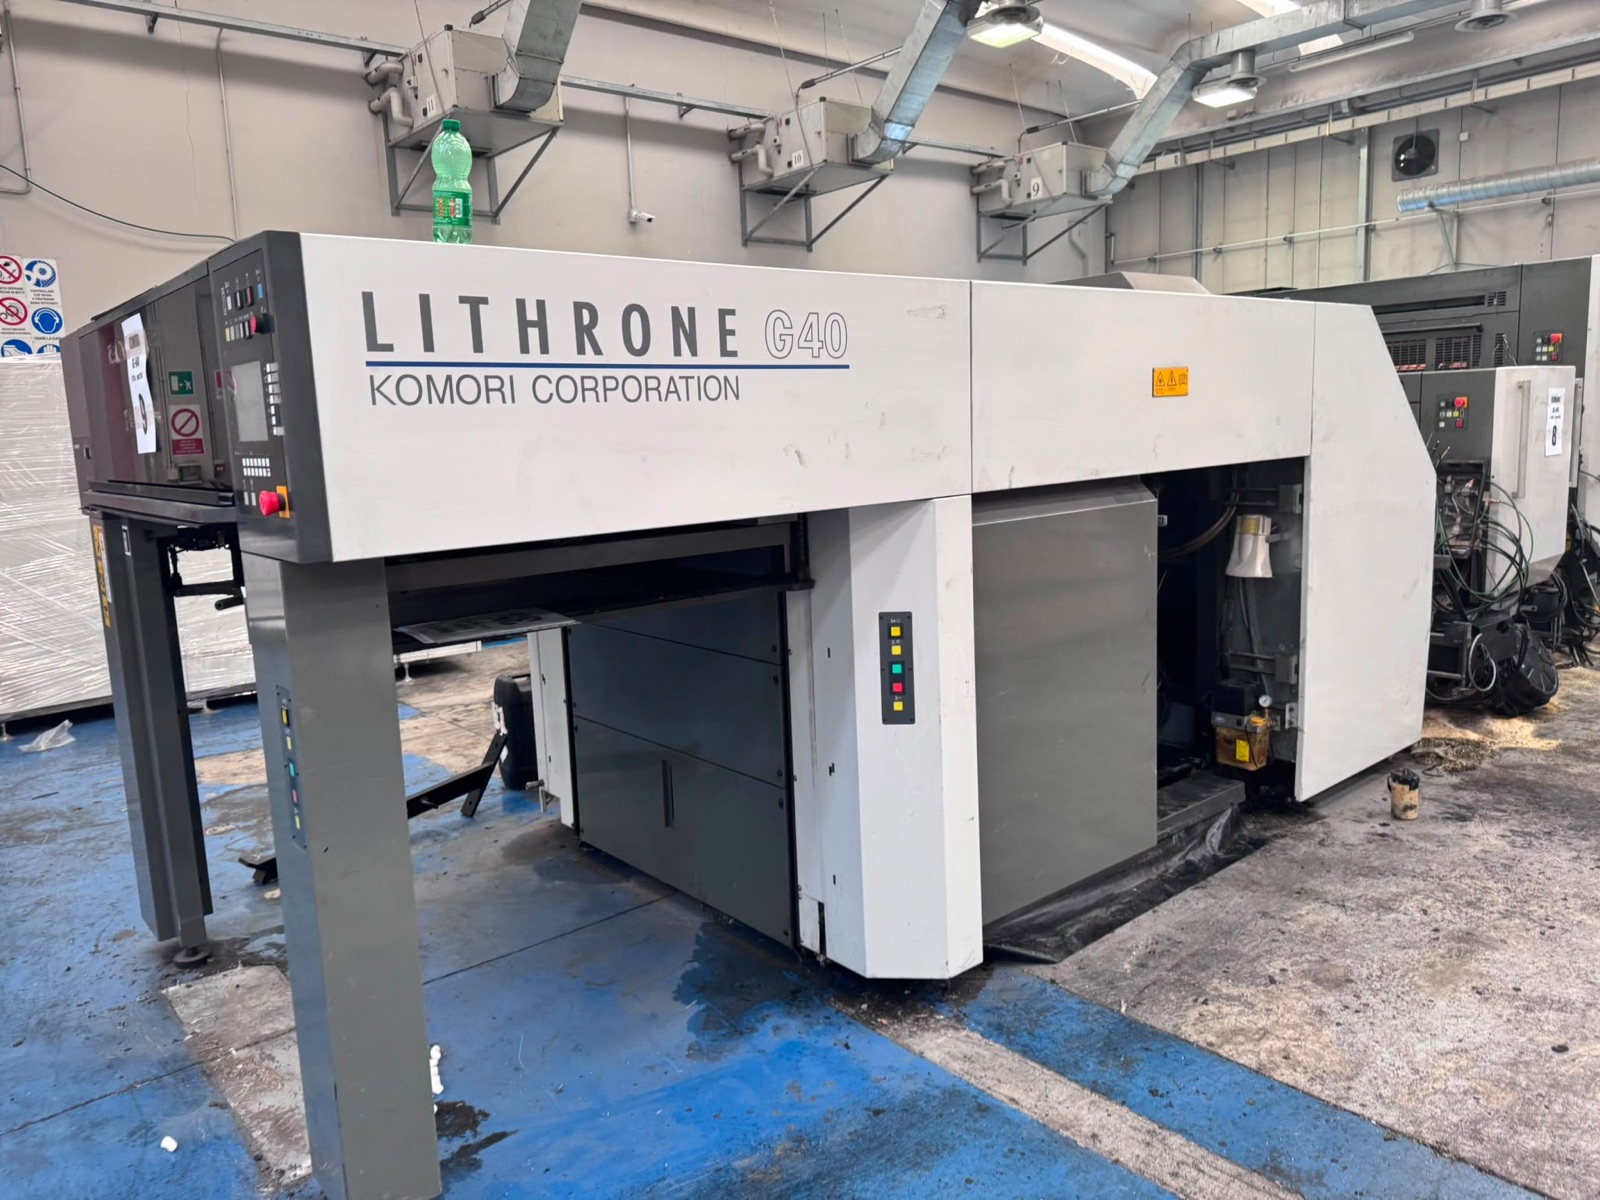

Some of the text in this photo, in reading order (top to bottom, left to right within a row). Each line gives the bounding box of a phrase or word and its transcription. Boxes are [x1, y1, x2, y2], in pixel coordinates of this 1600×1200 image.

[427, 99, 434, 112] 11
[794, 153, 802, 165] 10
[1032, 182, 1040, 197] 9
[361, 291, 849, 360] LITHRONE G40
[369, 374, 740, 406] KOMORI CORPORATION
[138, 393, 147, 435] 9
[1551, 425, 1557, 446] 8
